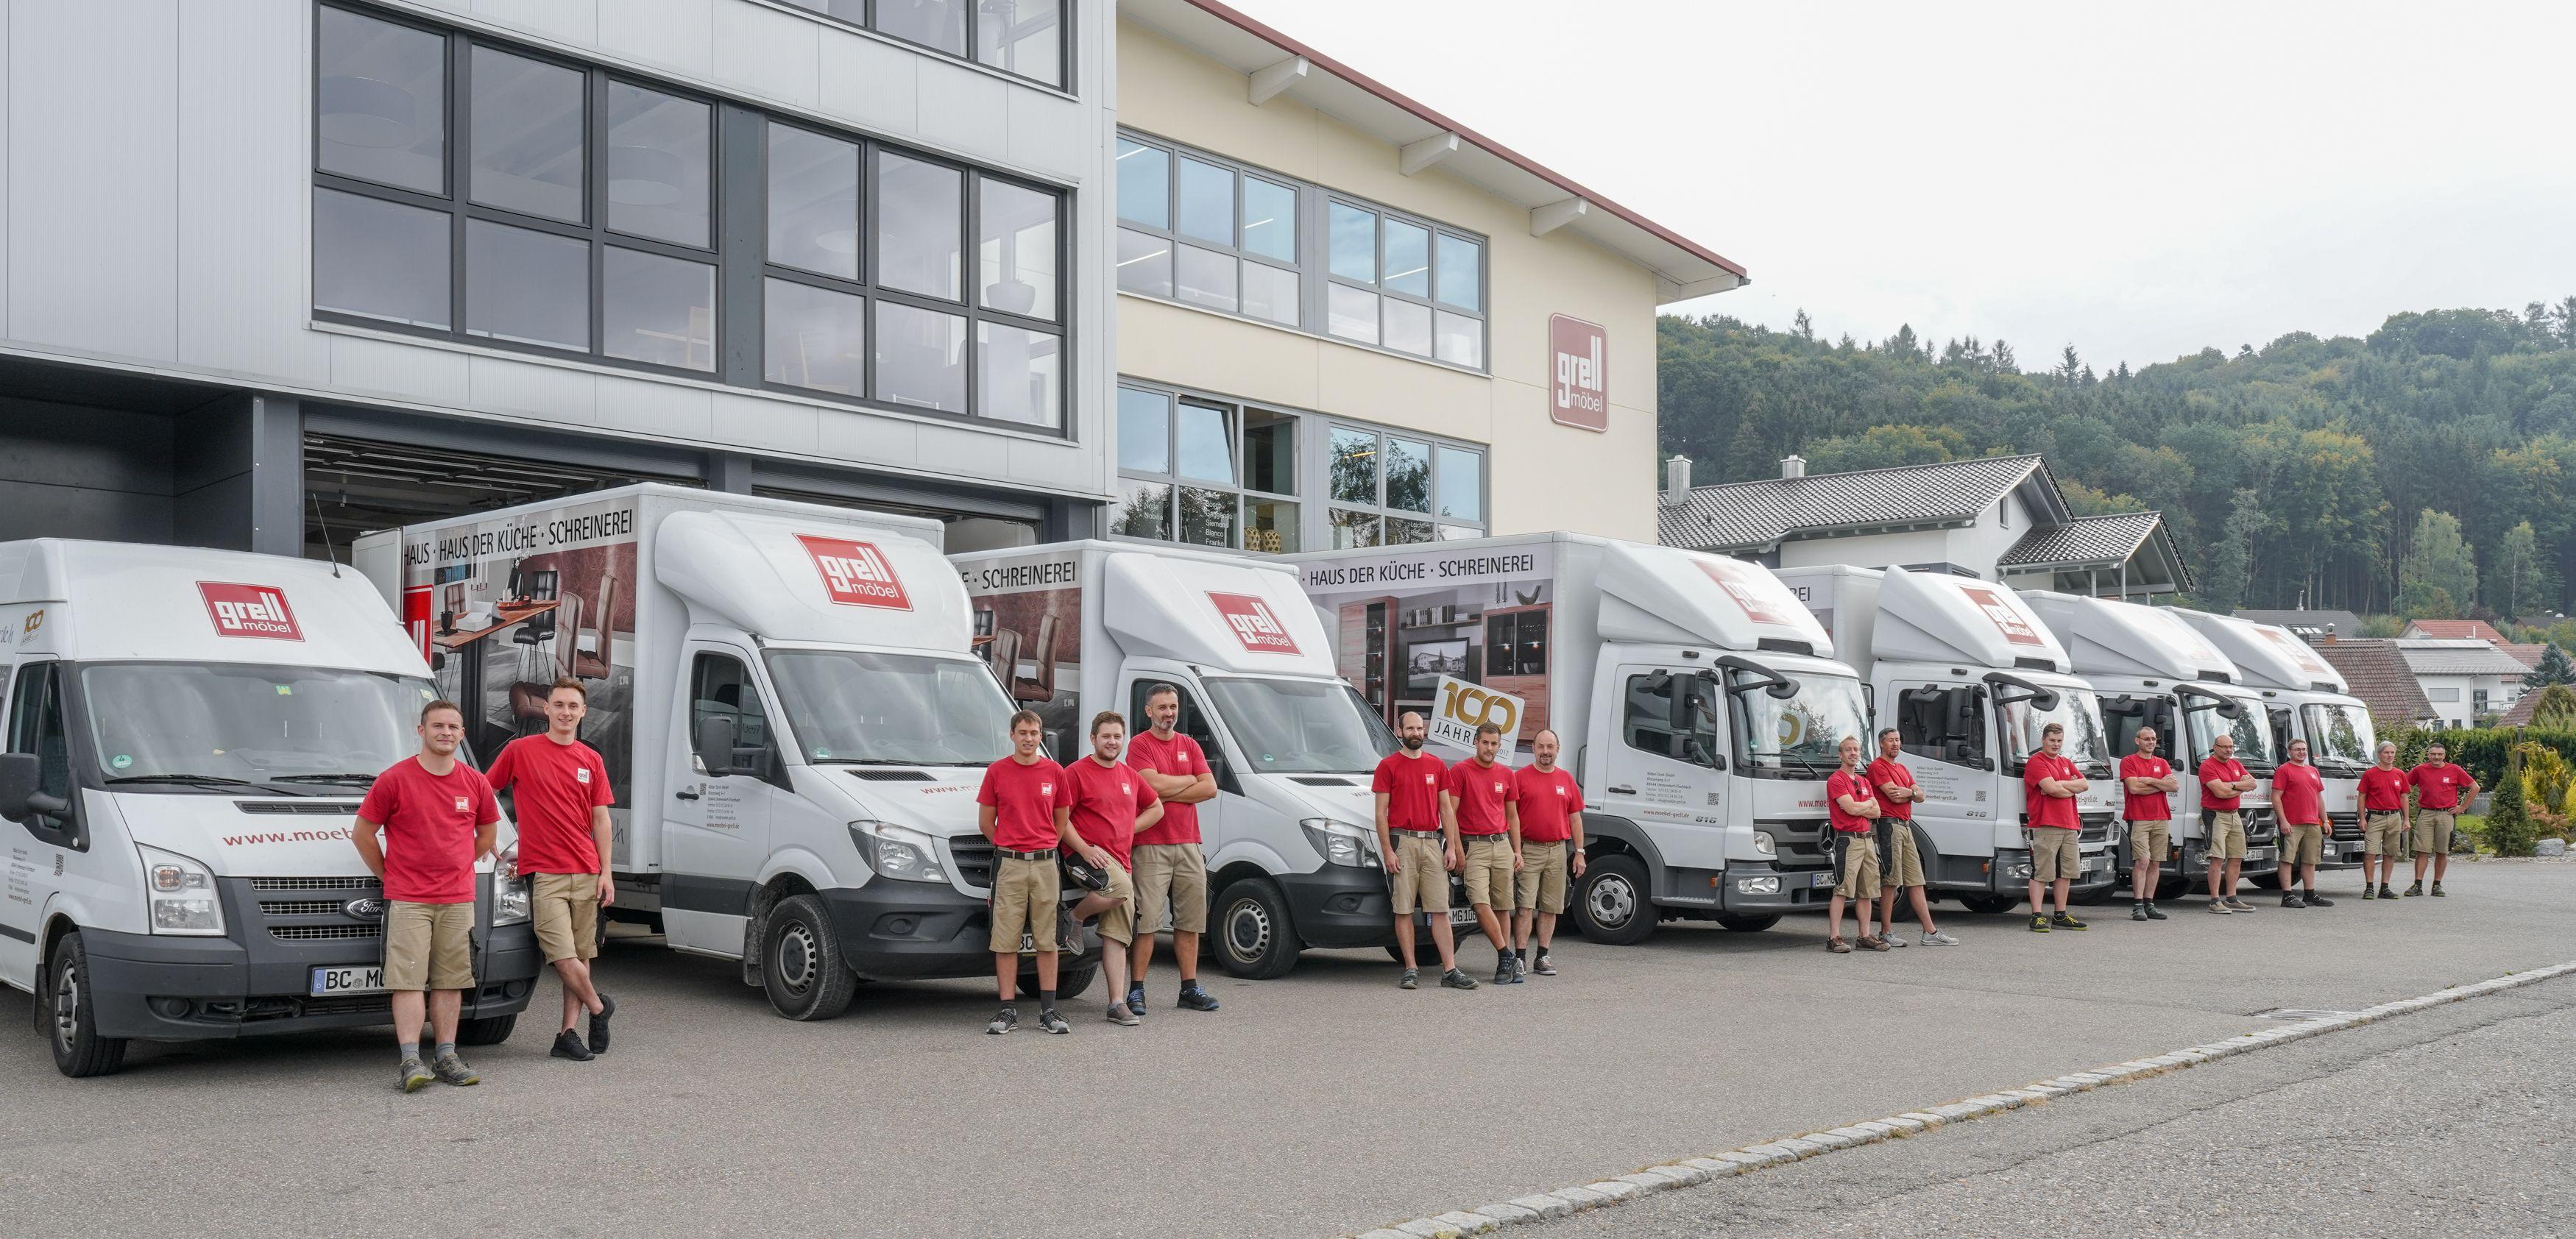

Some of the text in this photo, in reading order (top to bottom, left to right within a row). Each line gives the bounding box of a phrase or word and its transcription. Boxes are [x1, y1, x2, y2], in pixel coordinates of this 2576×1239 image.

[1557, 335, 1602, 409] grell
[1571, 391, 1602, 413] möbel
[439, 536, 469, 561] HAUS
[473, 532, 494, 556] DER
[498, 523, 537, 553] KÜCHE
[548, 509, 632, 545] SCHREINEREI
[1206, 529, 1225, 537] Blanco
[1206, 539, 1225, 547] Franke
[818, 546, 893, 593] grell
[983, 561, 1076, 589] SCHREINEREI
[1310, 554, 1534, 586] HAUS DER KÜCHE SCHREINEREI
[852, 582, 899, 598] möbel
[24, 609, 44, 634] 100
[213, 592, 288, 629] grell
[242, 621, 291, 633] möbel
[1226, 602, 1284, 644] grell
[1257, 634, 1292, 647] möbel
[1443, 681, 1517, 735] 100
[1643, 810, 1690, 818] www.moebel-grell.de
[1798, 800, 1830, 808] www.moe
[1452, 909, 1462, 922] MG
[325, 970, 352, 990] BC
